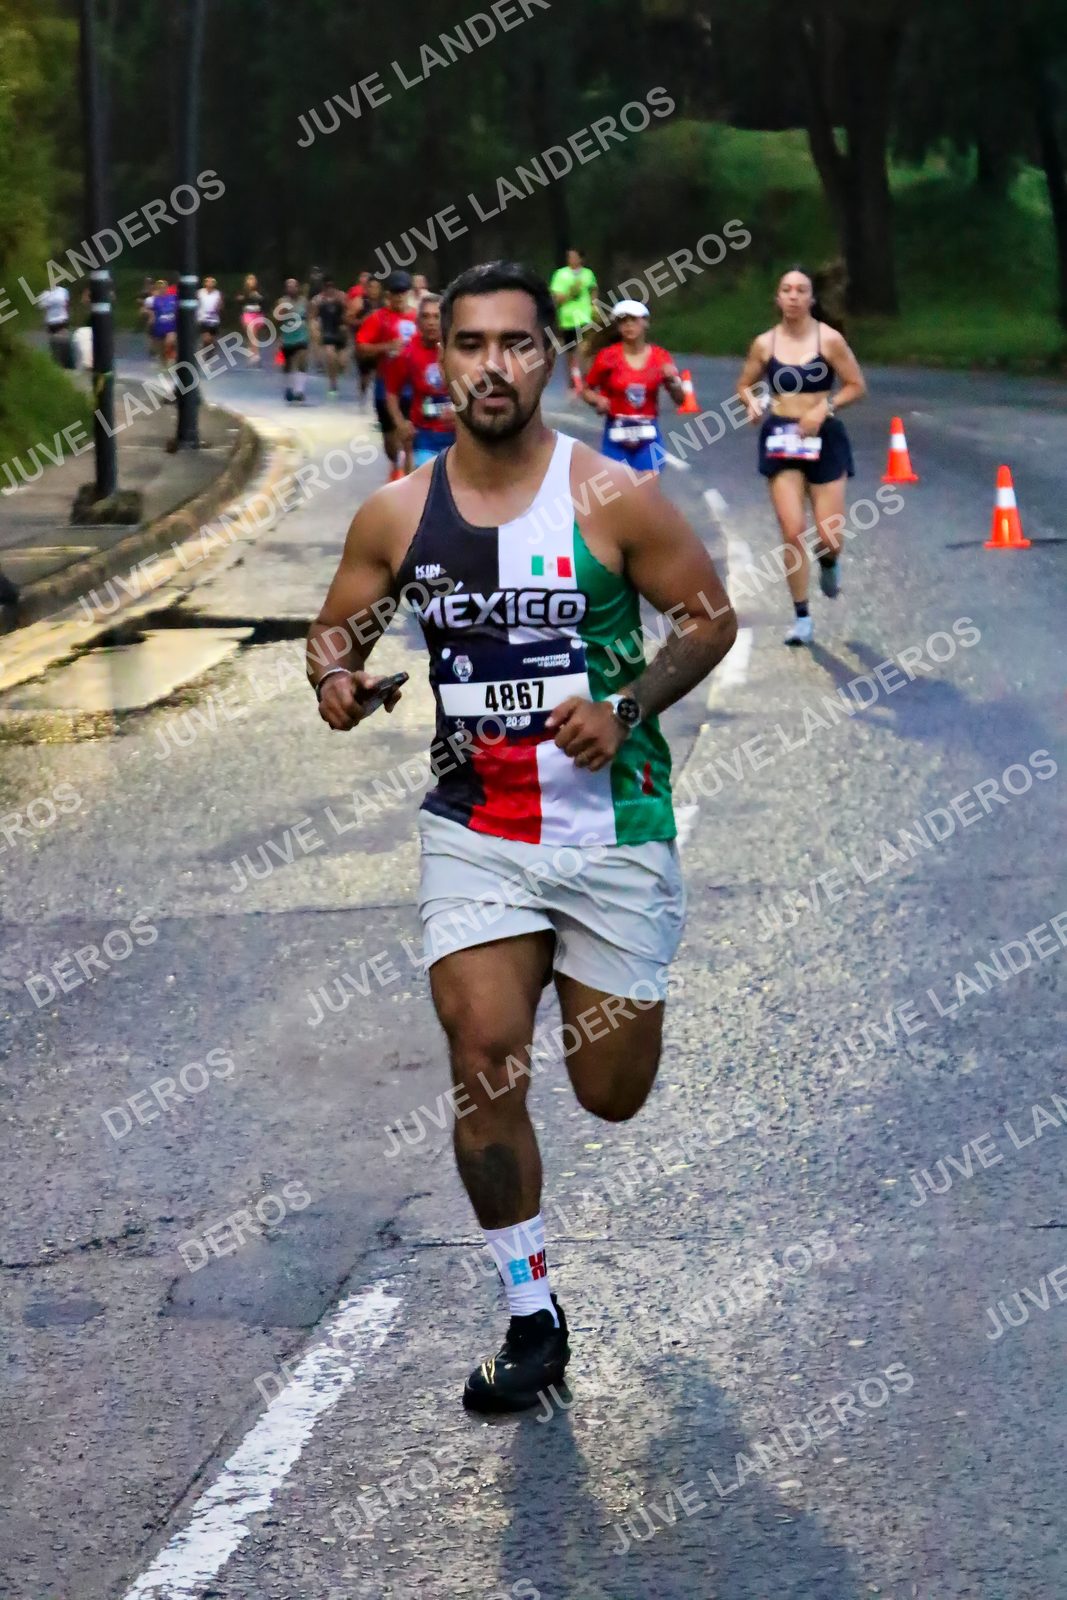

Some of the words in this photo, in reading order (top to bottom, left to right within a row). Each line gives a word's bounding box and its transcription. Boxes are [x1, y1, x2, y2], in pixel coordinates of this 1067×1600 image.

[415, 564, 440, 578] KIN
[414, 580, 587, 627] MÉXICO
[485, 681, 545, 712] 4867
